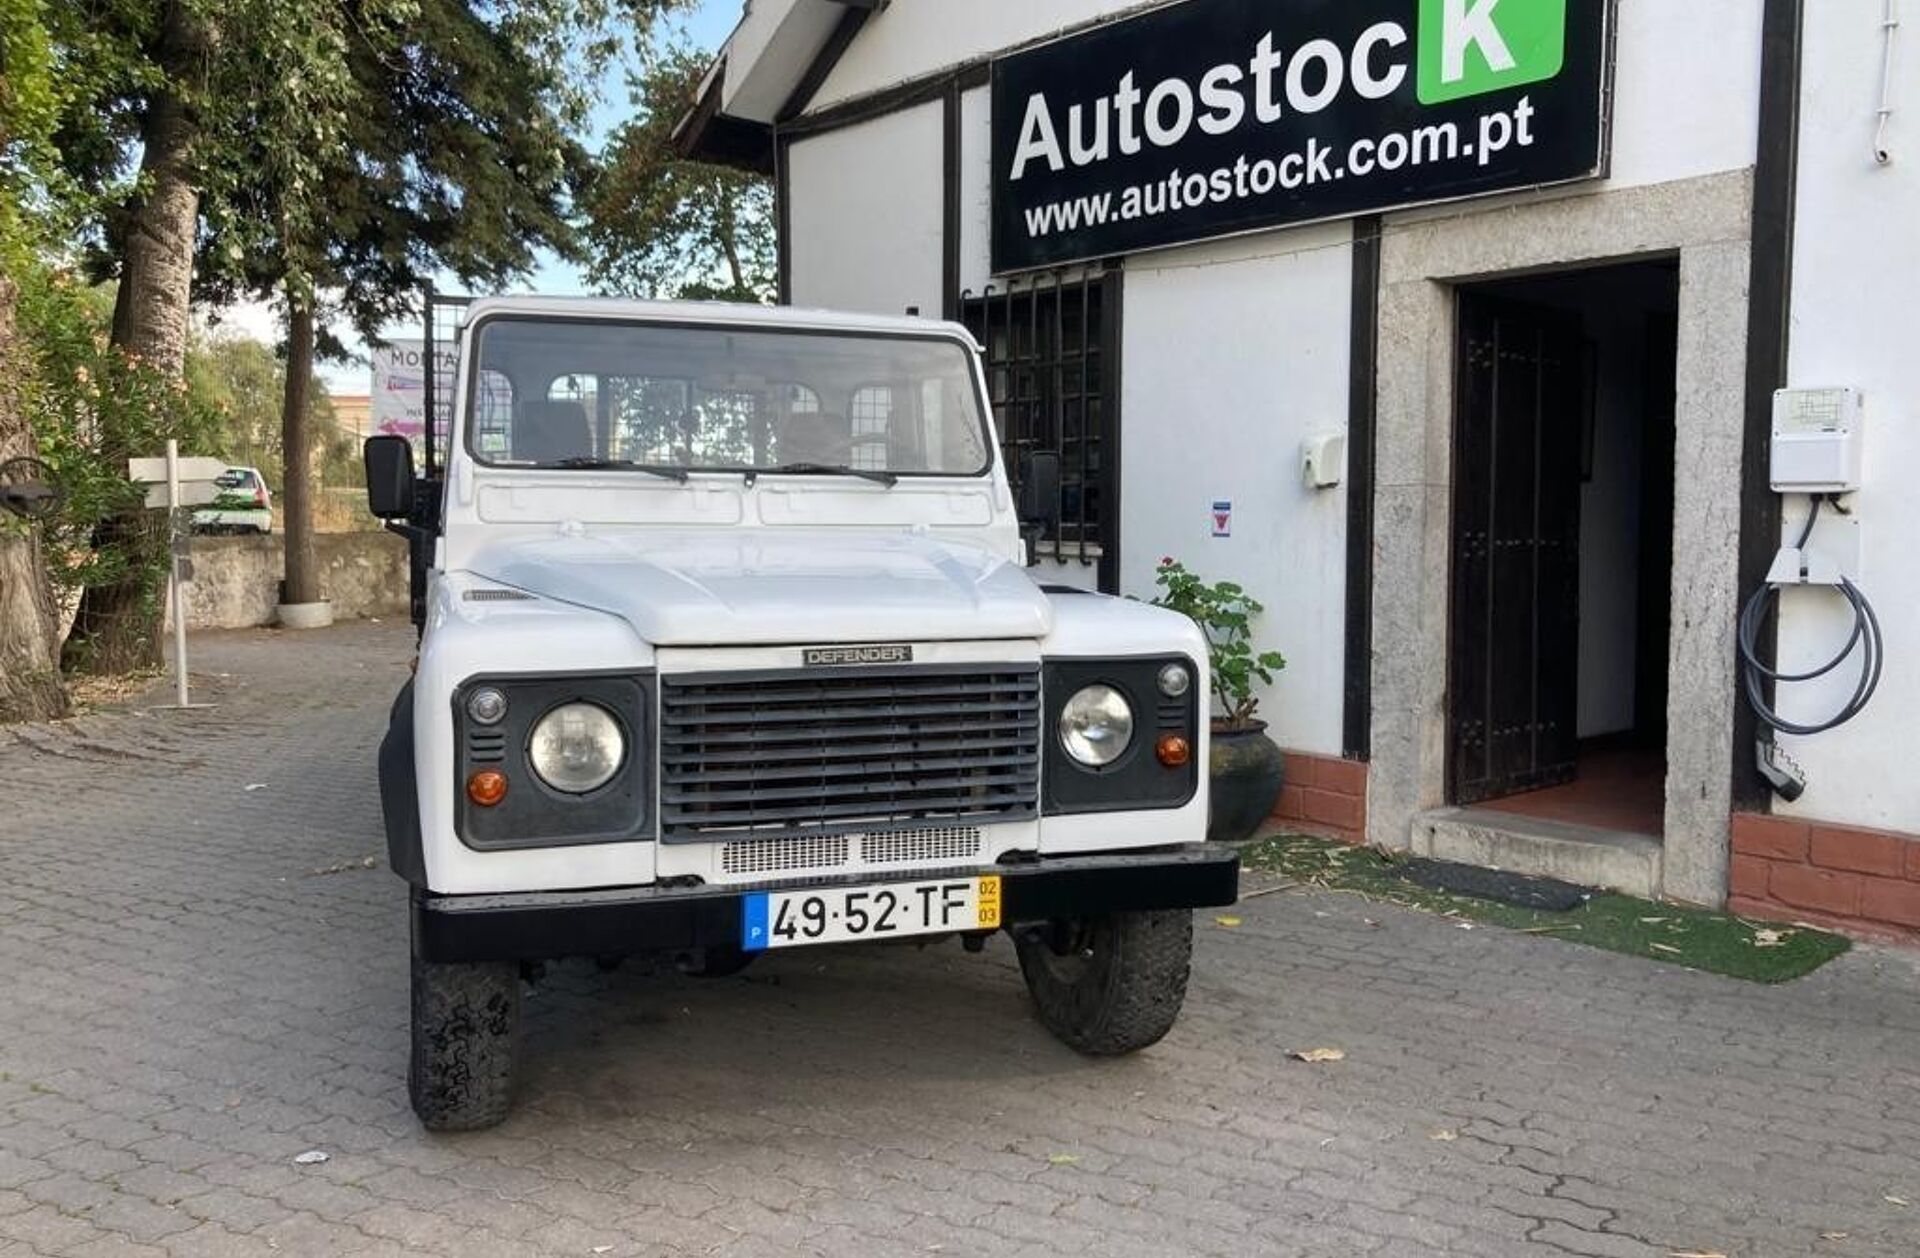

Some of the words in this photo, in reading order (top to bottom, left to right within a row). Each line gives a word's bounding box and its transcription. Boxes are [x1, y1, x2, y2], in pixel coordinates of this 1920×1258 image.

[1024, 94, 1534, 237] www.autostock.com.pt
[806, 647, 905, 664] DEFENDER
[979, 881, 996, 895] 02
[979, 908, 996, 922] 03
[751, 926, 761, 938] P
